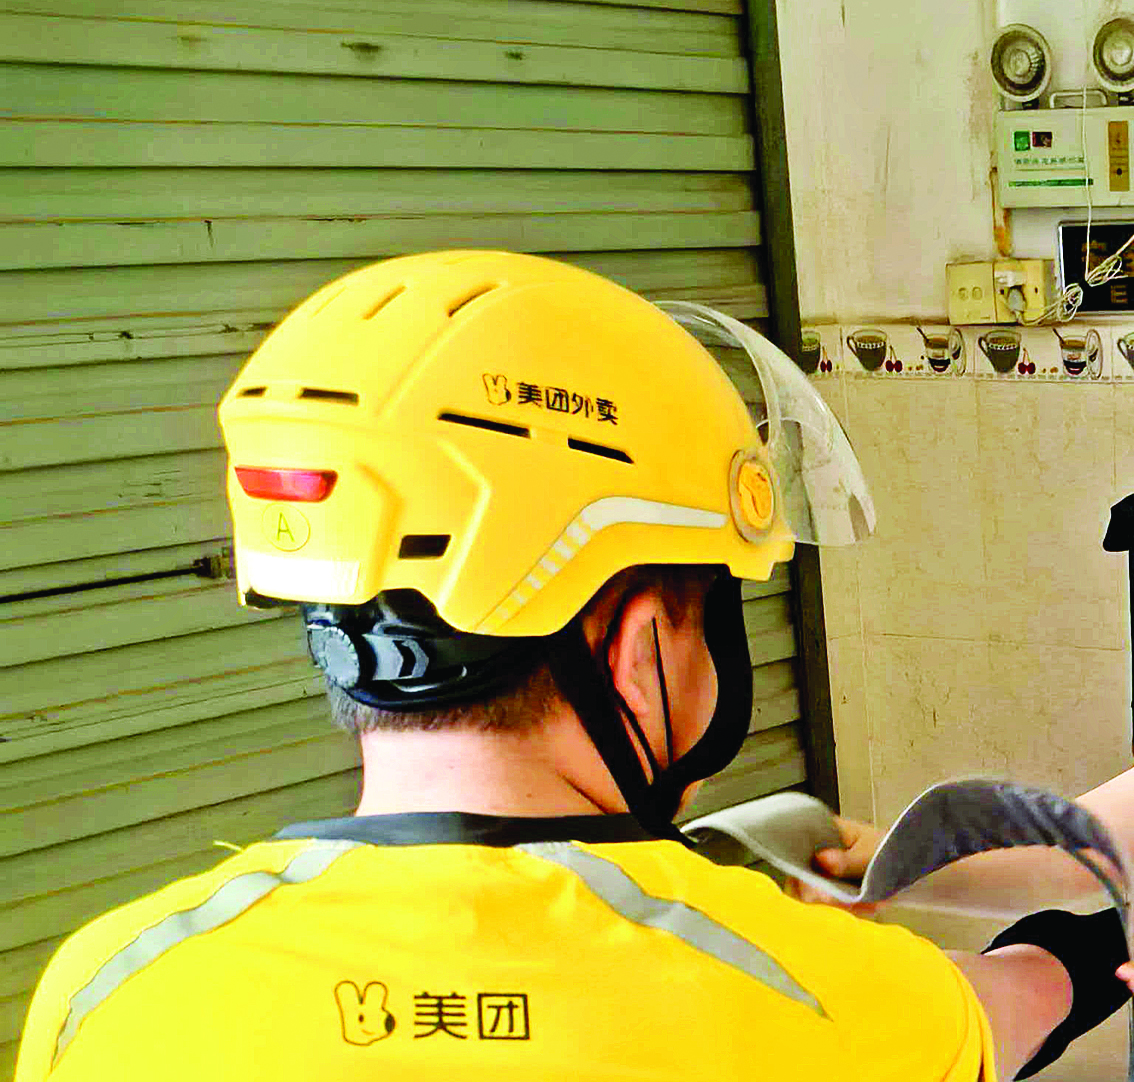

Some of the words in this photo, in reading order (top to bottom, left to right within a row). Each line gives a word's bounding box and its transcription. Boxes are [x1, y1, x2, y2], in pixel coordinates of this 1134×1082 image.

[517, 382, 618, 425] 美团外卖
[276, 512, 295, 542] A
[413, 991, 530, 1040] 美团
